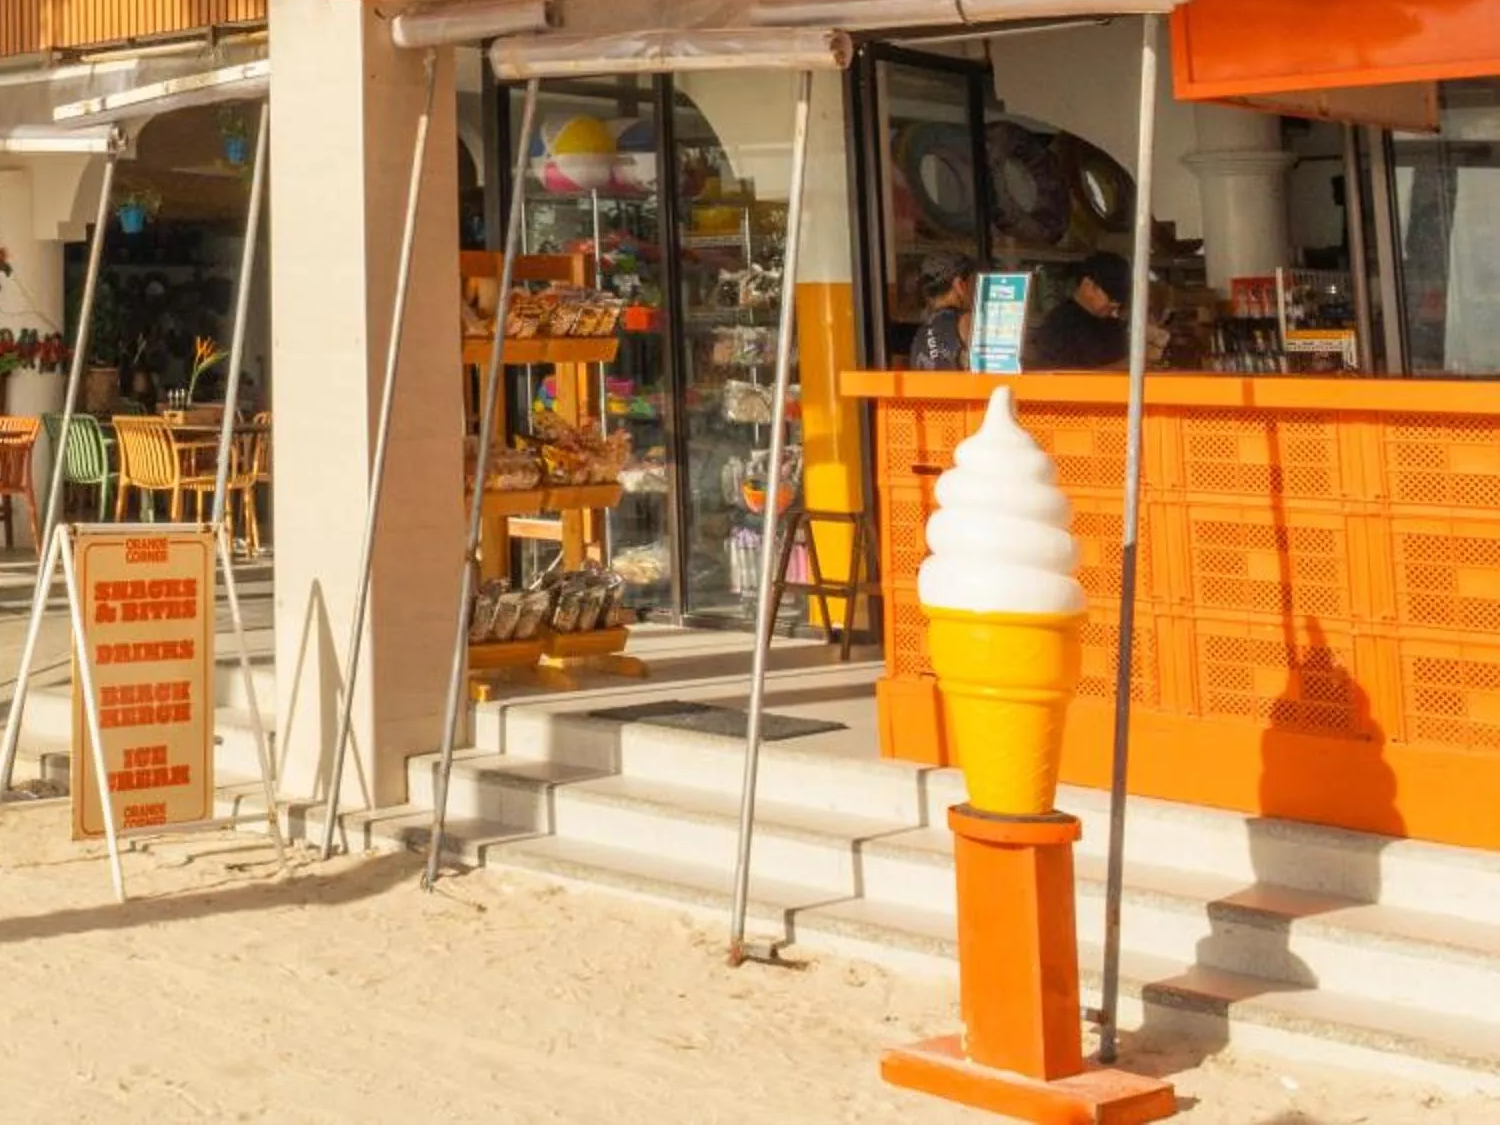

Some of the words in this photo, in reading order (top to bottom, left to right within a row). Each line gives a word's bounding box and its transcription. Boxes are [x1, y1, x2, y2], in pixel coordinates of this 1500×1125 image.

[125, 538, 168, 550] ORANGE
[125, 550, 168, 564] CORNER
[94, 578, 197, 601] SNACKS
[94, 602, 117, 623] &
[121, 599, 197, 622] BITES
[95, 640, 195, 665] DRINKS
[100, 681, 191, 705] BEACH
[123, 745, 168, 768] ICE
